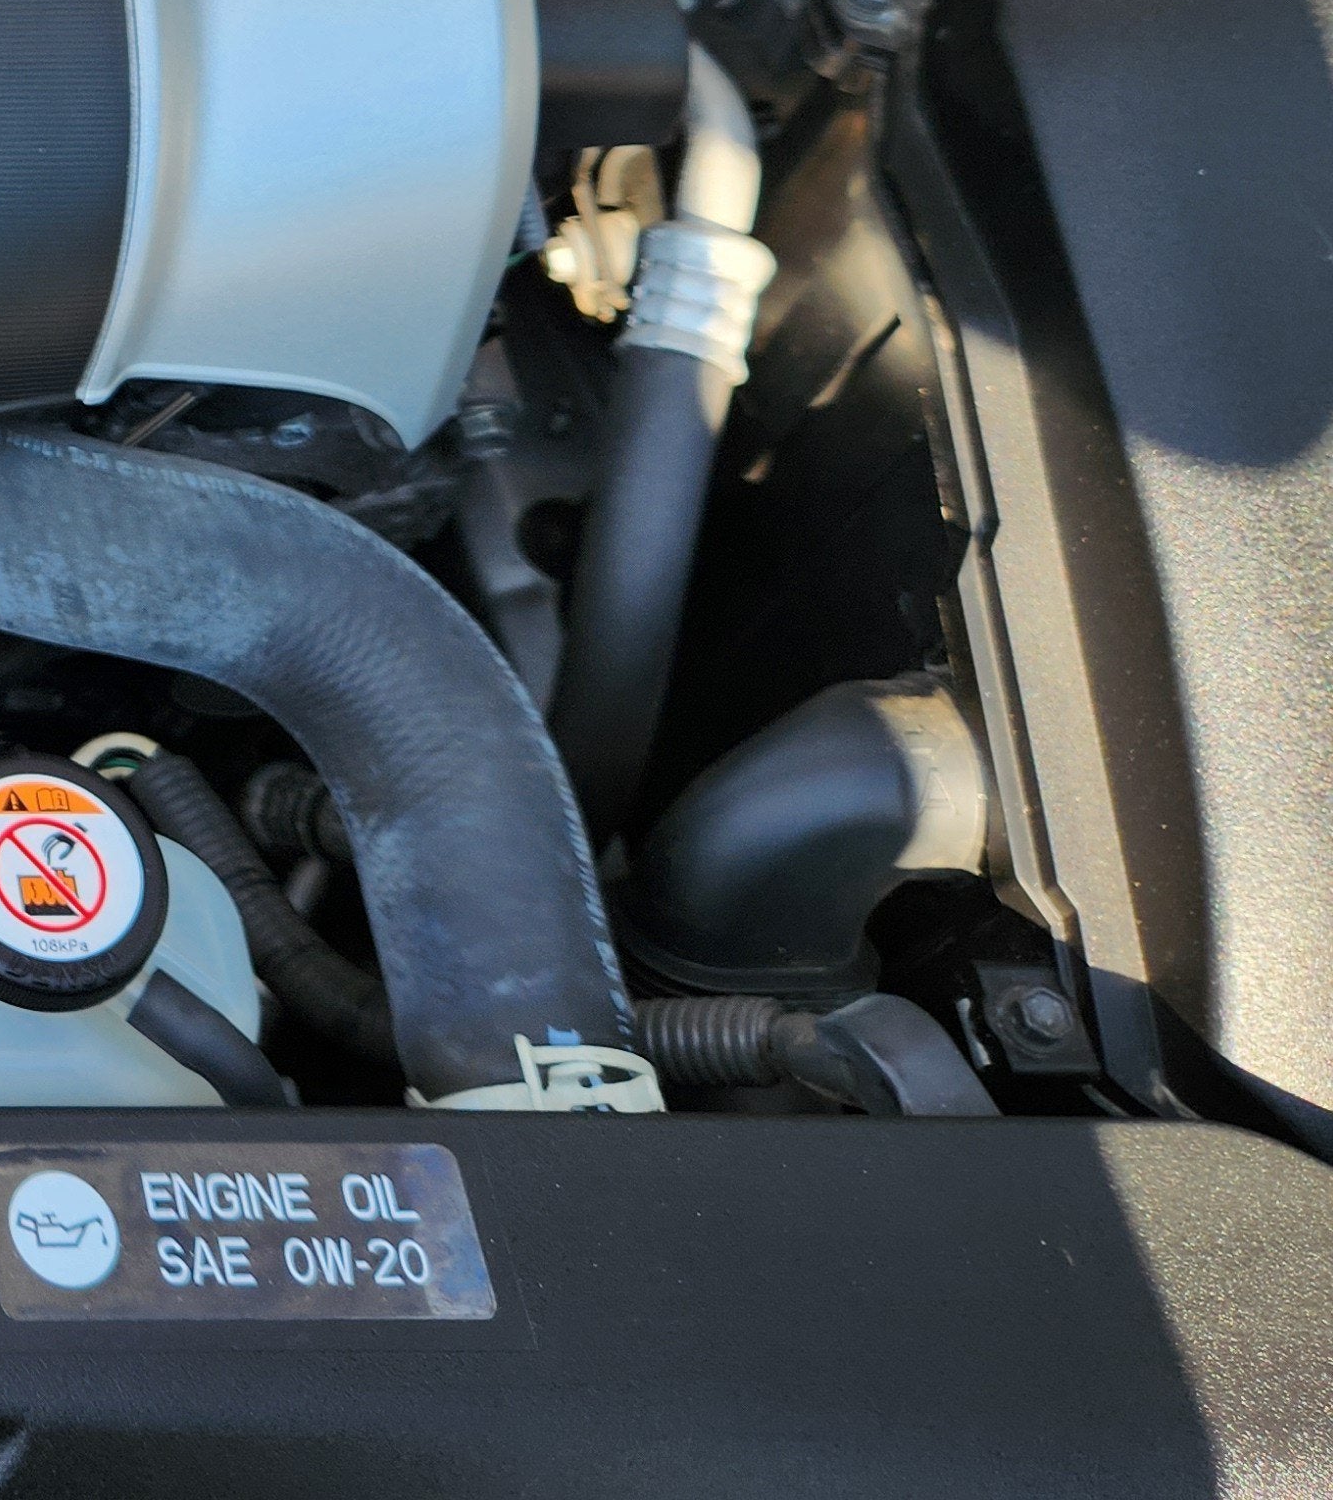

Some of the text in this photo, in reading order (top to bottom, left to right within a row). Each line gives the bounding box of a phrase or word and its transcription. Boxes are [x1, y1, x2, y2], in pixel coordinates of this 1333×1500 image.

[31, 938, 90, 954] 108kPa
[140, 1171, 421, 1223] ENGINE OIL
[156, 1236, 429, 1287] SAE 0W-20
